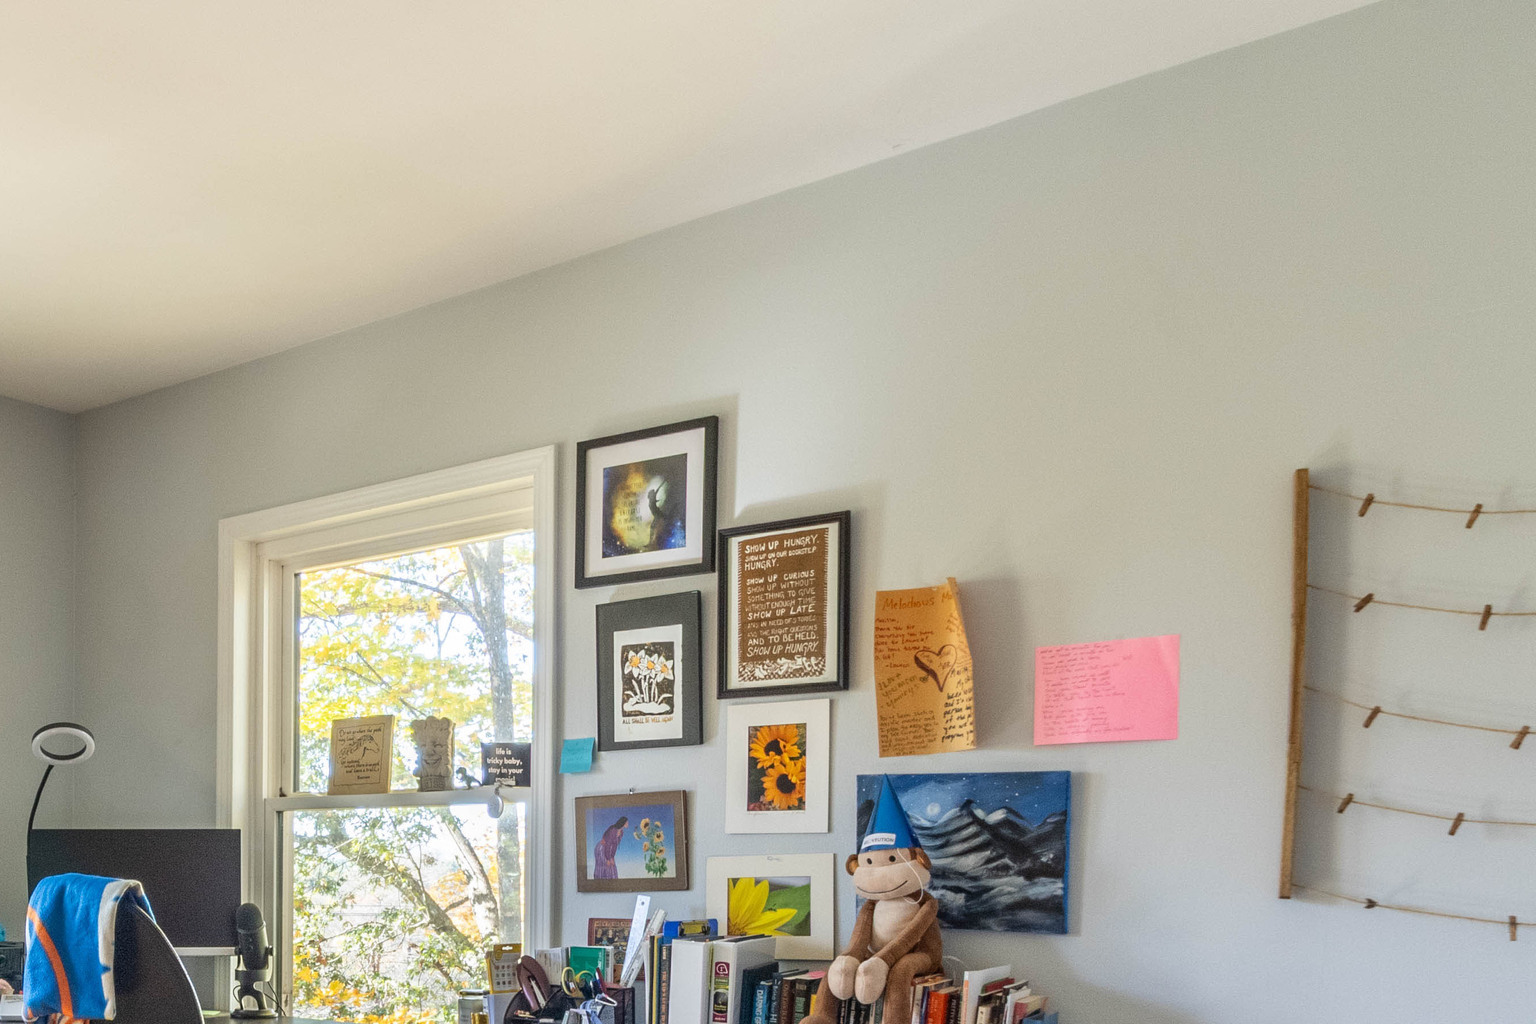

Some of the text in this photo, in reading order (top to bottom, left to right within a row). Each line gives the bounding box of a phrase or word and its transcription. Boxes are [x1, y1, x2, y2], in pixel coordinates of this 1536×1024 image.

[745, 534, 819, 554] SHOW UP HUNGRY.
[744, 558, 779, 571] HUNGRY.
[745, 554, 758, 562] SHOW
[746, 570, 815, 586] SHOW UP CURIOUS
[747, 578, 816, 595] SHOW UP WITHOUT
[747, 587, 816, 603] SOMETHING TO GIVE
[747, 603, 815, 620] SHOW UP LATE
[748, 631, 819, 646] AND TO BE HELD.
[747, 641, 819, 657] SHOW UP HUNGRY.
[506, 747, 512, 755] is
[487, 757, 504, 766] tricky
[755, 989, 764, 1015] DARING
